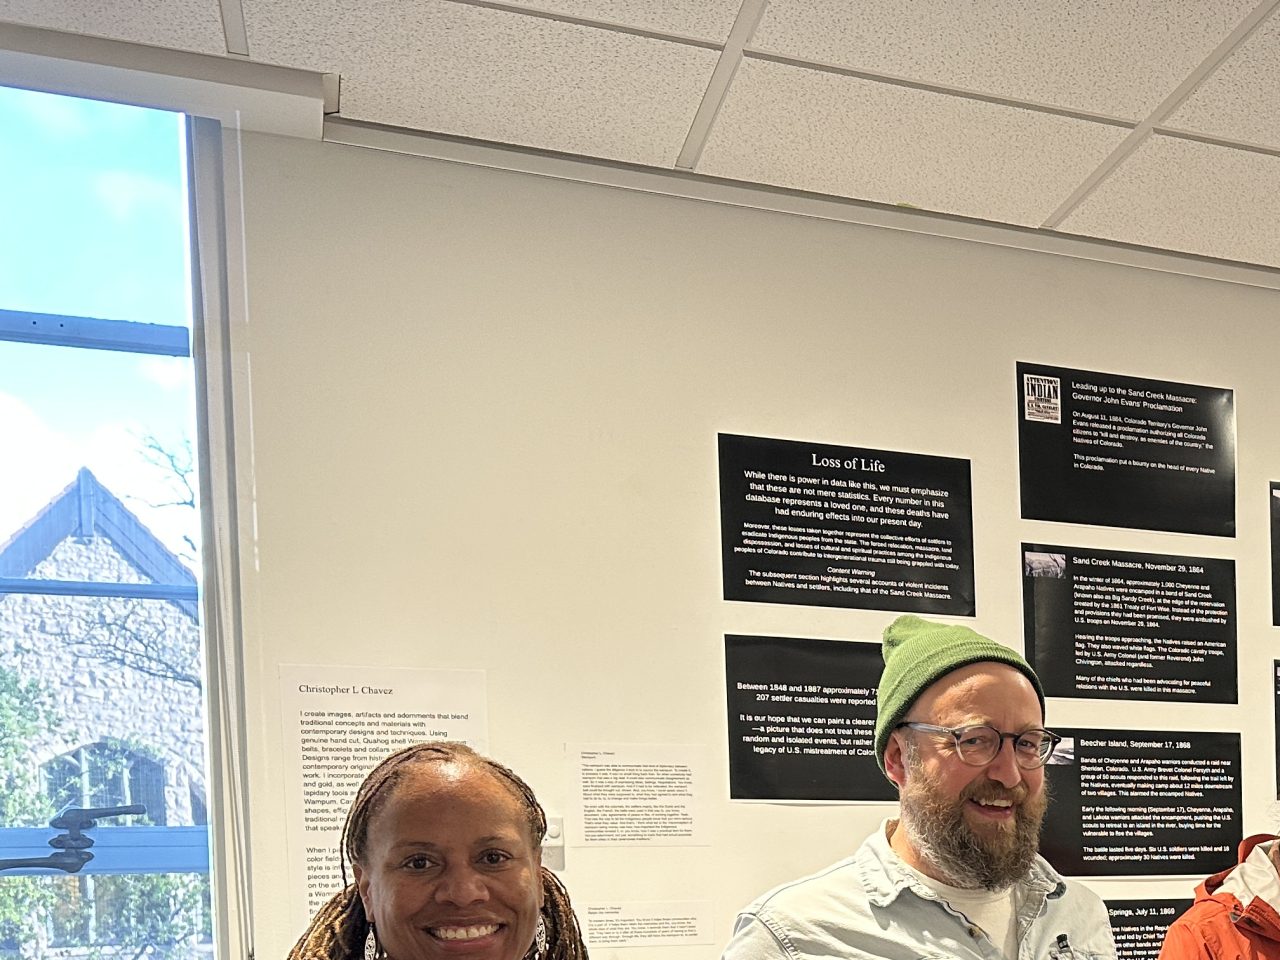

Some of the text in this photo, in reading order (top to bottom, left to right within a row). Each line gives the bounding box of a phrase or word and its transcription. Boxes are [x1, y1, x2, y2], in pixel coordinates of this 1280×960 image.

[812, 454, 885, 472] Loss of Life
[744, 470, 766, 479] While
[768, 473, 788, 481] there
[830, 479, 847, 487] data
[848, 480, 862, 488] like
[862, 482, 878, 491] this,
[910, 488, 949, 497] emphasize
[750, 482, 765, 491] that
[766, 484, 788, 493] these
[838, 492, 871, 500] statistics.
[873, 494, 894, 504] Every
[745, 494, 781, 503] database
[782, 498, 822, 507] represents
[830, 501, 851, 510] loved
[885, 506, 905, 515] these
[906, 508, 931, 517] deaths
[932, 511, 949, 519] have
[775, 507, 790, 515] had
[791, 510, 824, 520] enduring
[825, 512, 850, 521] effects
[880, 518, 907, 526] present
[298, 685, 350, 695] Christopher
[822, 687, 870, 696] approximately
[848, 697, 876, 706] reported
[767, 715, 786, 723] hope
[766, 725, 790, 733] picture
[753, 746, 777, 754] legacy
